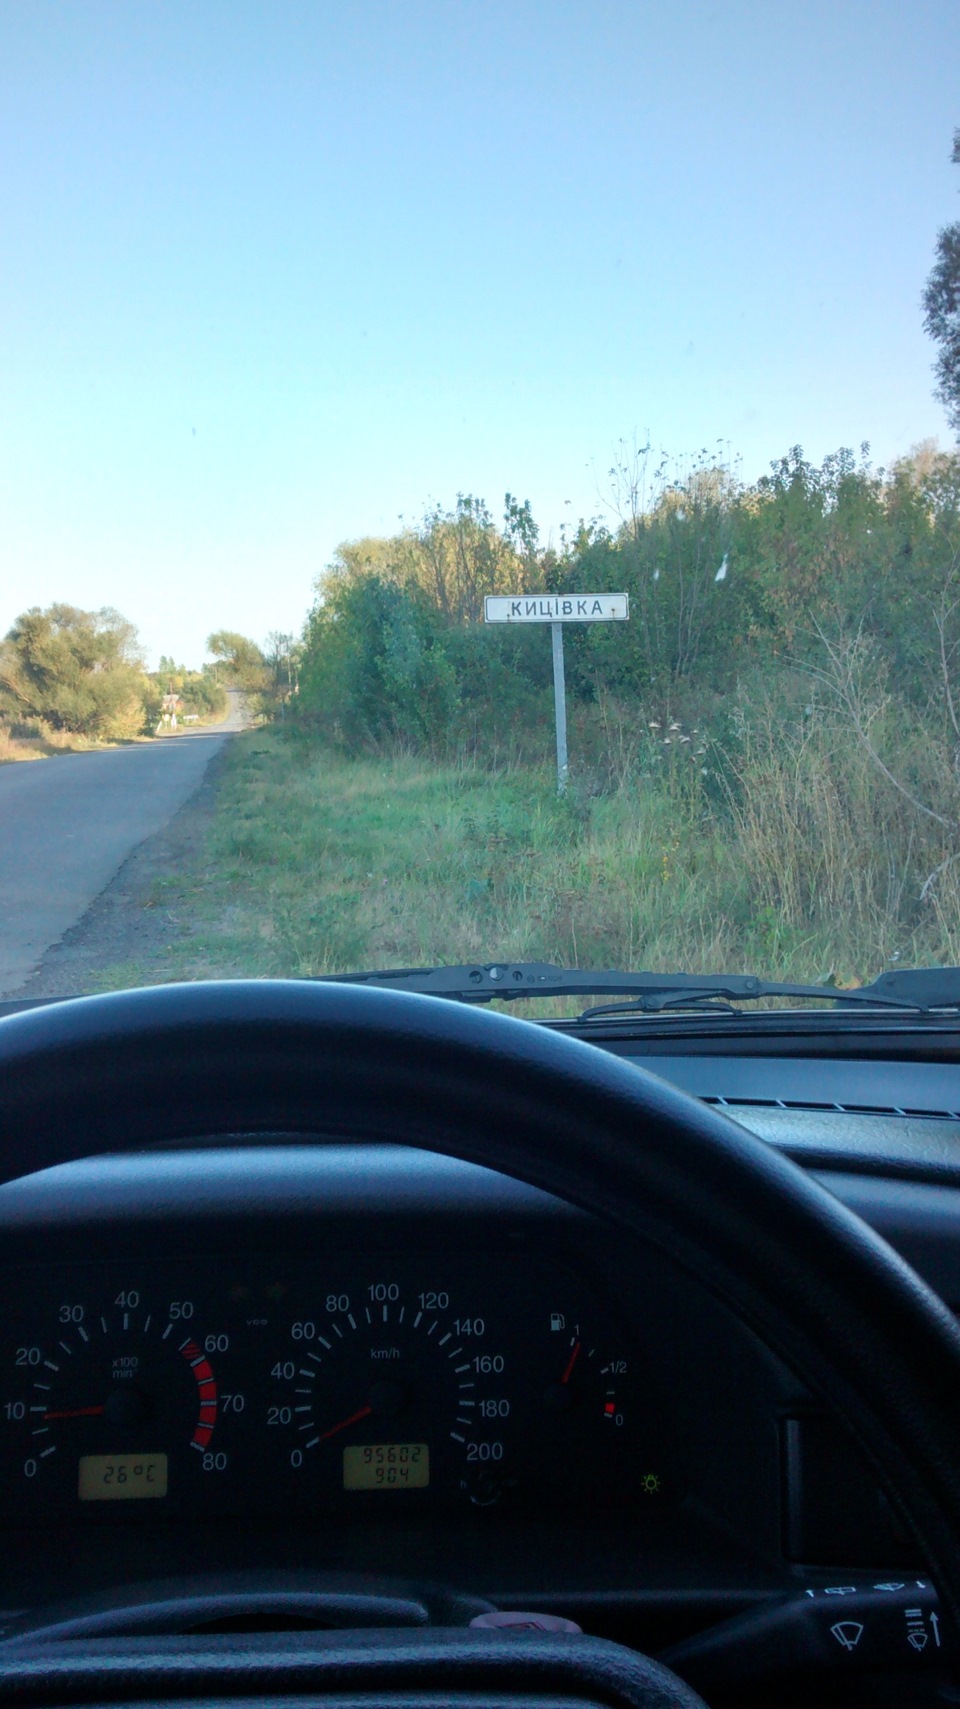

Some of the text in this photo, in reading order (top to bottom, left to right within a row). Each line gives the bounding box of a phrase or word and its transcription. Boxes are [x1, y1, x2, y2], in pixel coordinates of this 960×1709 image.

[511, 598, 603, 617] КИЦІВКА
[114, 1291, 140, 1308] 40
[367, 1283, 399, 1301] 100
[418, 1292, 449, 1309] 120
[169, 1302, 194, 1319] 50
[325, 1294, 350, 1312] 80
[59, 1305, 84, 1323] 30
[291, 1322, 315, 1340] 60
[453, 1318, 485, 1336] 140
[574, 1324, 579, 1336] 1
[204, 1334, 229, 1352] 60
[15, 1348, 41, 1365] 20
[370, 1348, 400, 1359] km/h
[270, 1362, 295, 1380] 40
[472, 1355, 504, 1373] 160
[609, 1361, 627, 1374] 1/2
[3, 1402, 25, 1420] 10
[220, 1395, 245, 1412] 70
[479, 1400, 510, 1417] 180
[267, 1407, 292, 1425] 20
[615, 1414, 624, 1426] 0
[290, 1450, 302, 1467] 0
[363, 1447, 421, 1463] 95602
[466, 1443, 503, 1461] 200
[24, 1459, 37, 1477] 0
[202, 1453, 227, 1470] 80
[376, 1467, 408, 1483] 904
